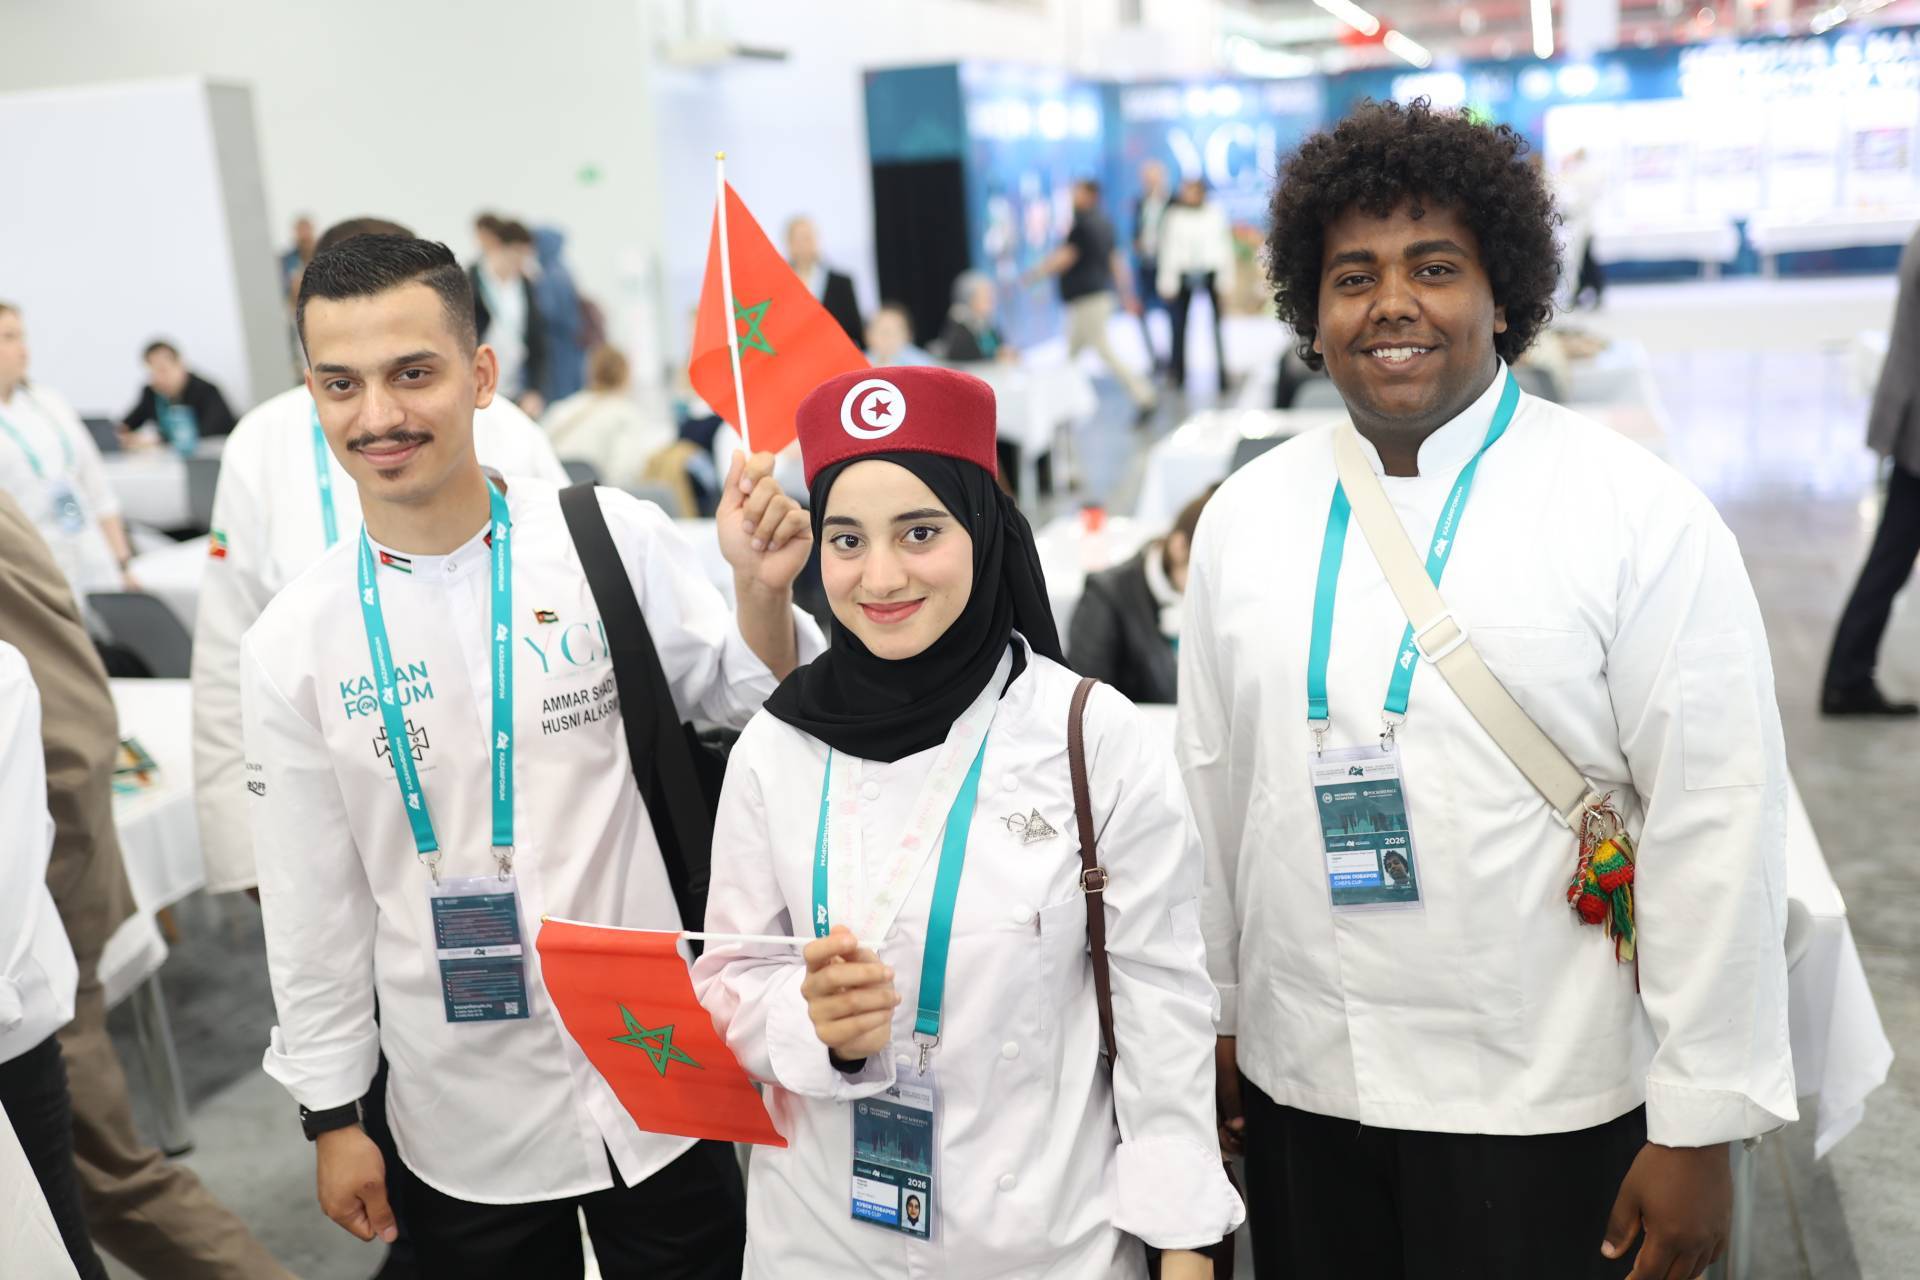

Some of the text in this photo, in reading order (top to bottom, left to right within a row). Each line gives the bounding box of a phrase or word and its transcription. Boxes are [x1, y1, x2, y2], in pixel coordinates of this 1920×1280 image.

[340, 661, 428, 698] KAAN
[344, 682, 434, 720] FOUM
[543, 689, 590, 714] AMMAR
[542, 712, 581, 735] HUSNI
[1384, 836, 1406, 845] 2026
[907, 1177, 927, 1189] 2026
